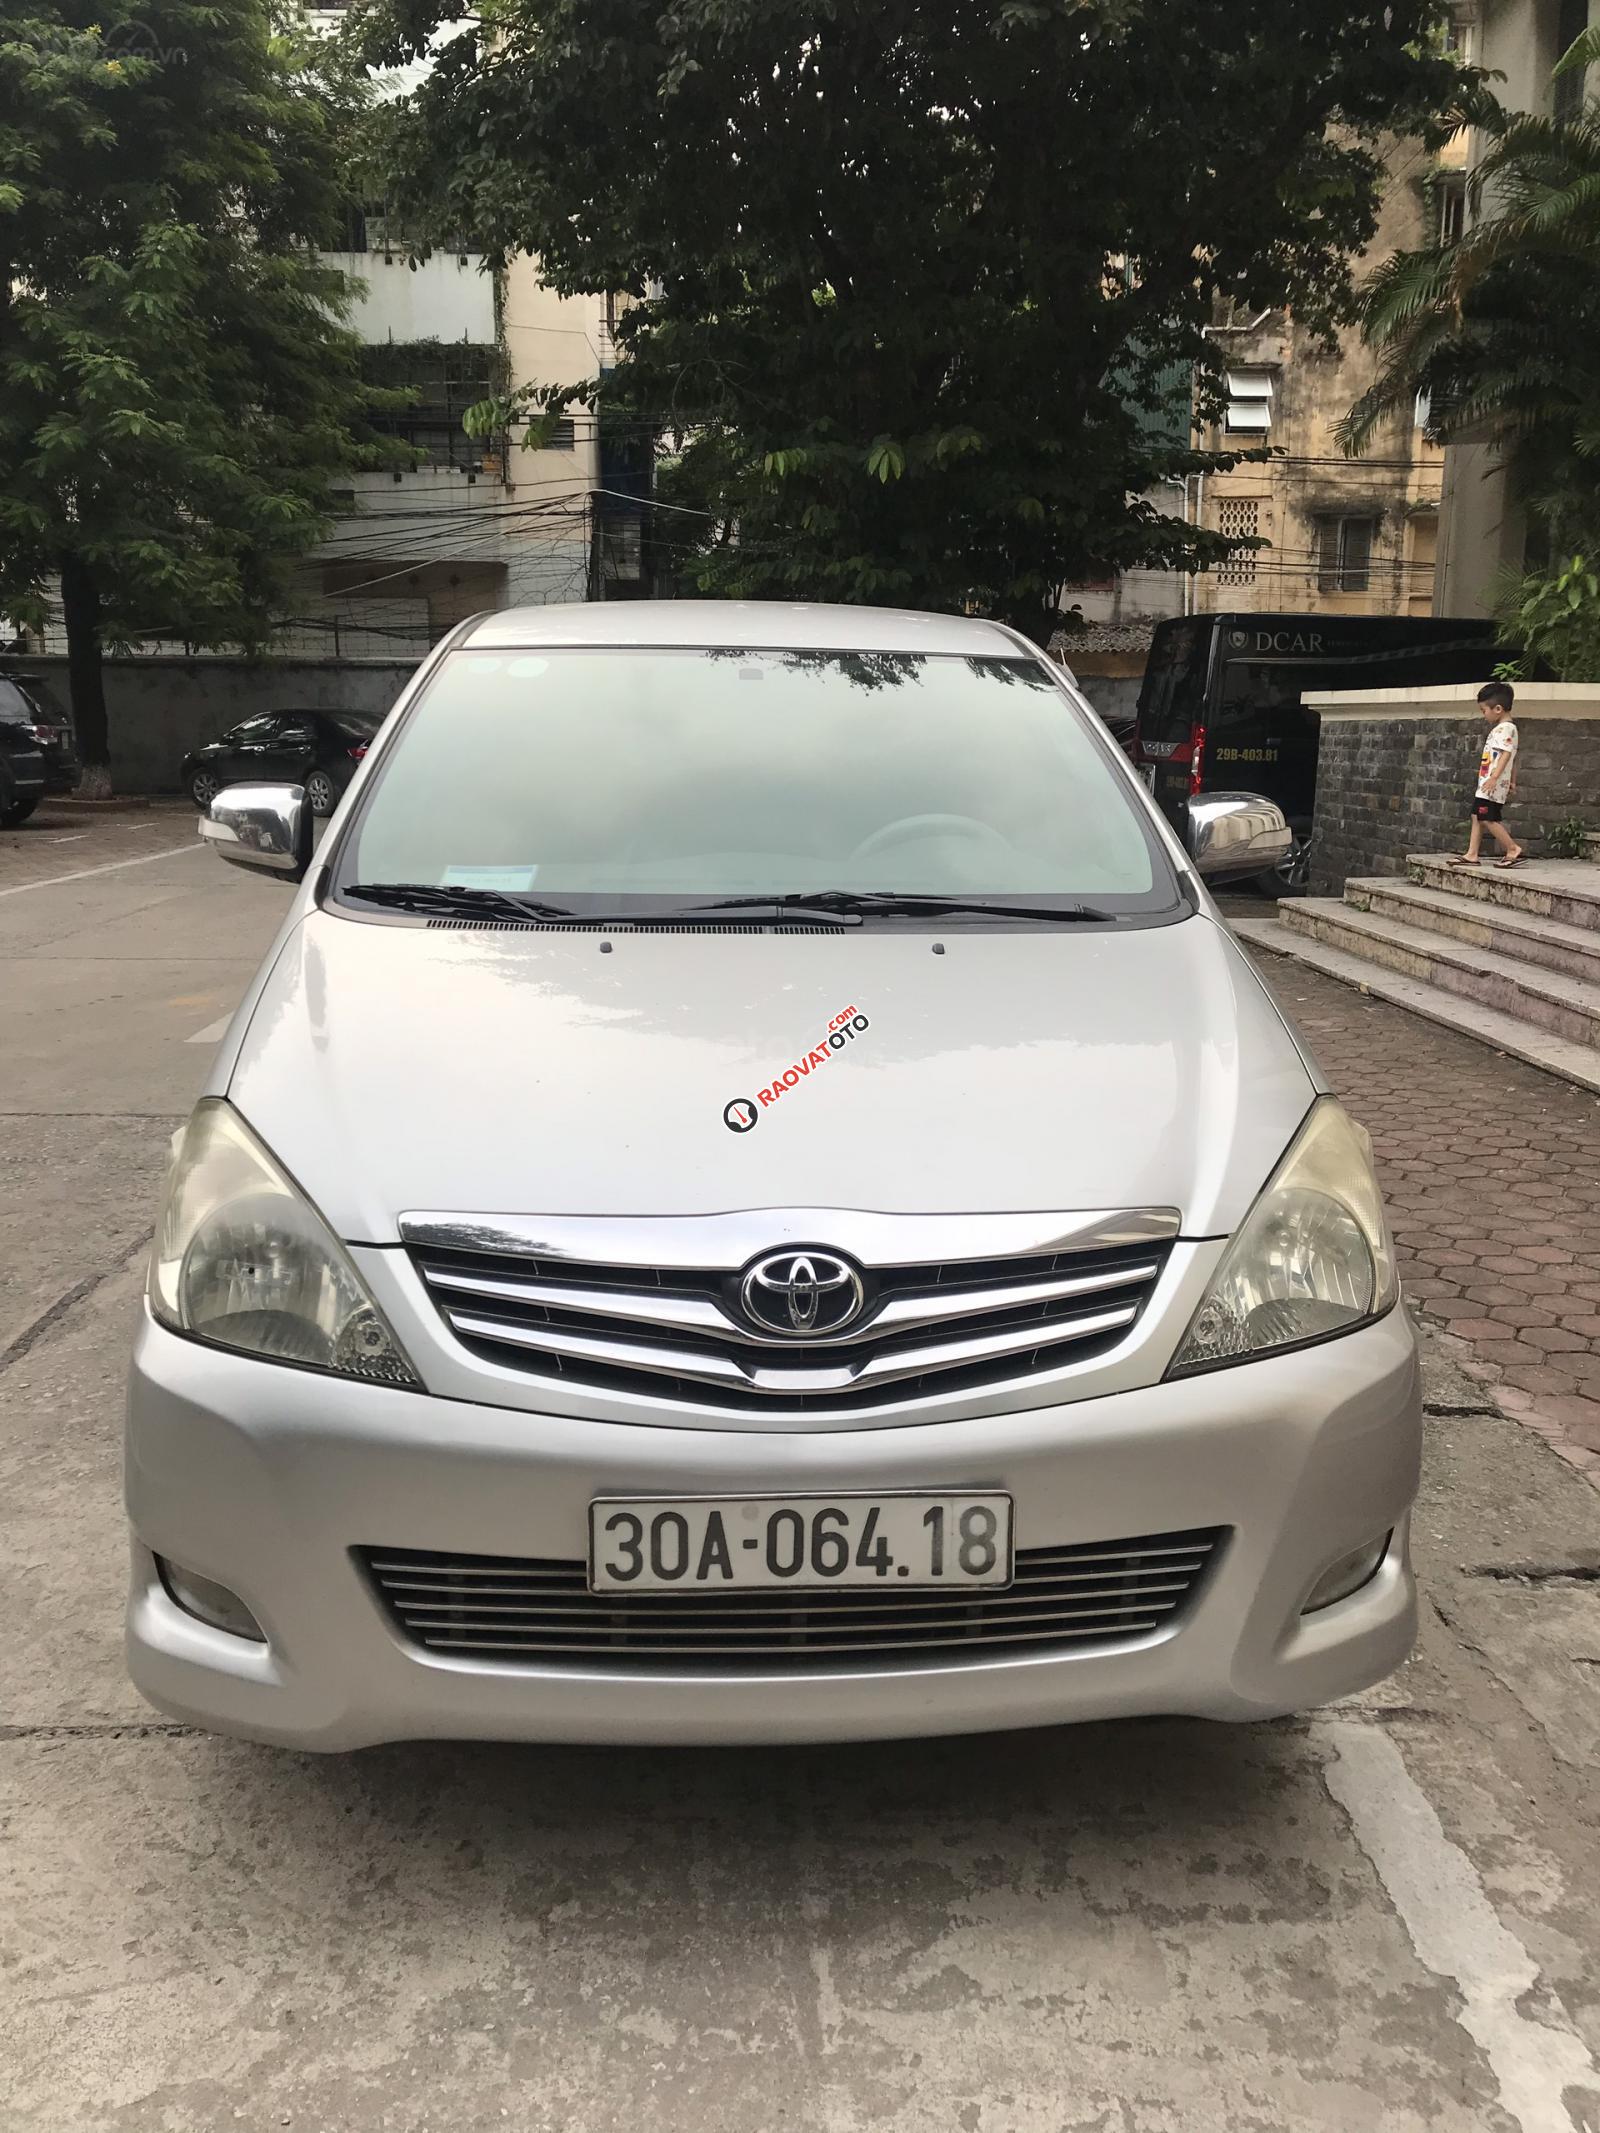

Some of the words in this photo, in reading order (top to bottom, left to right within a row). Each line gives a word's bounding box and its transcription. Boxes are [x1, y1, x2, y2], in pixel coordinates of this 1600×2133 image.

[1256, 632, 1324, 652] DCAR
[1216, 748, 1278, 761] 29B-403.81
[605, 1506, 997, 1581] 30A-064.18
